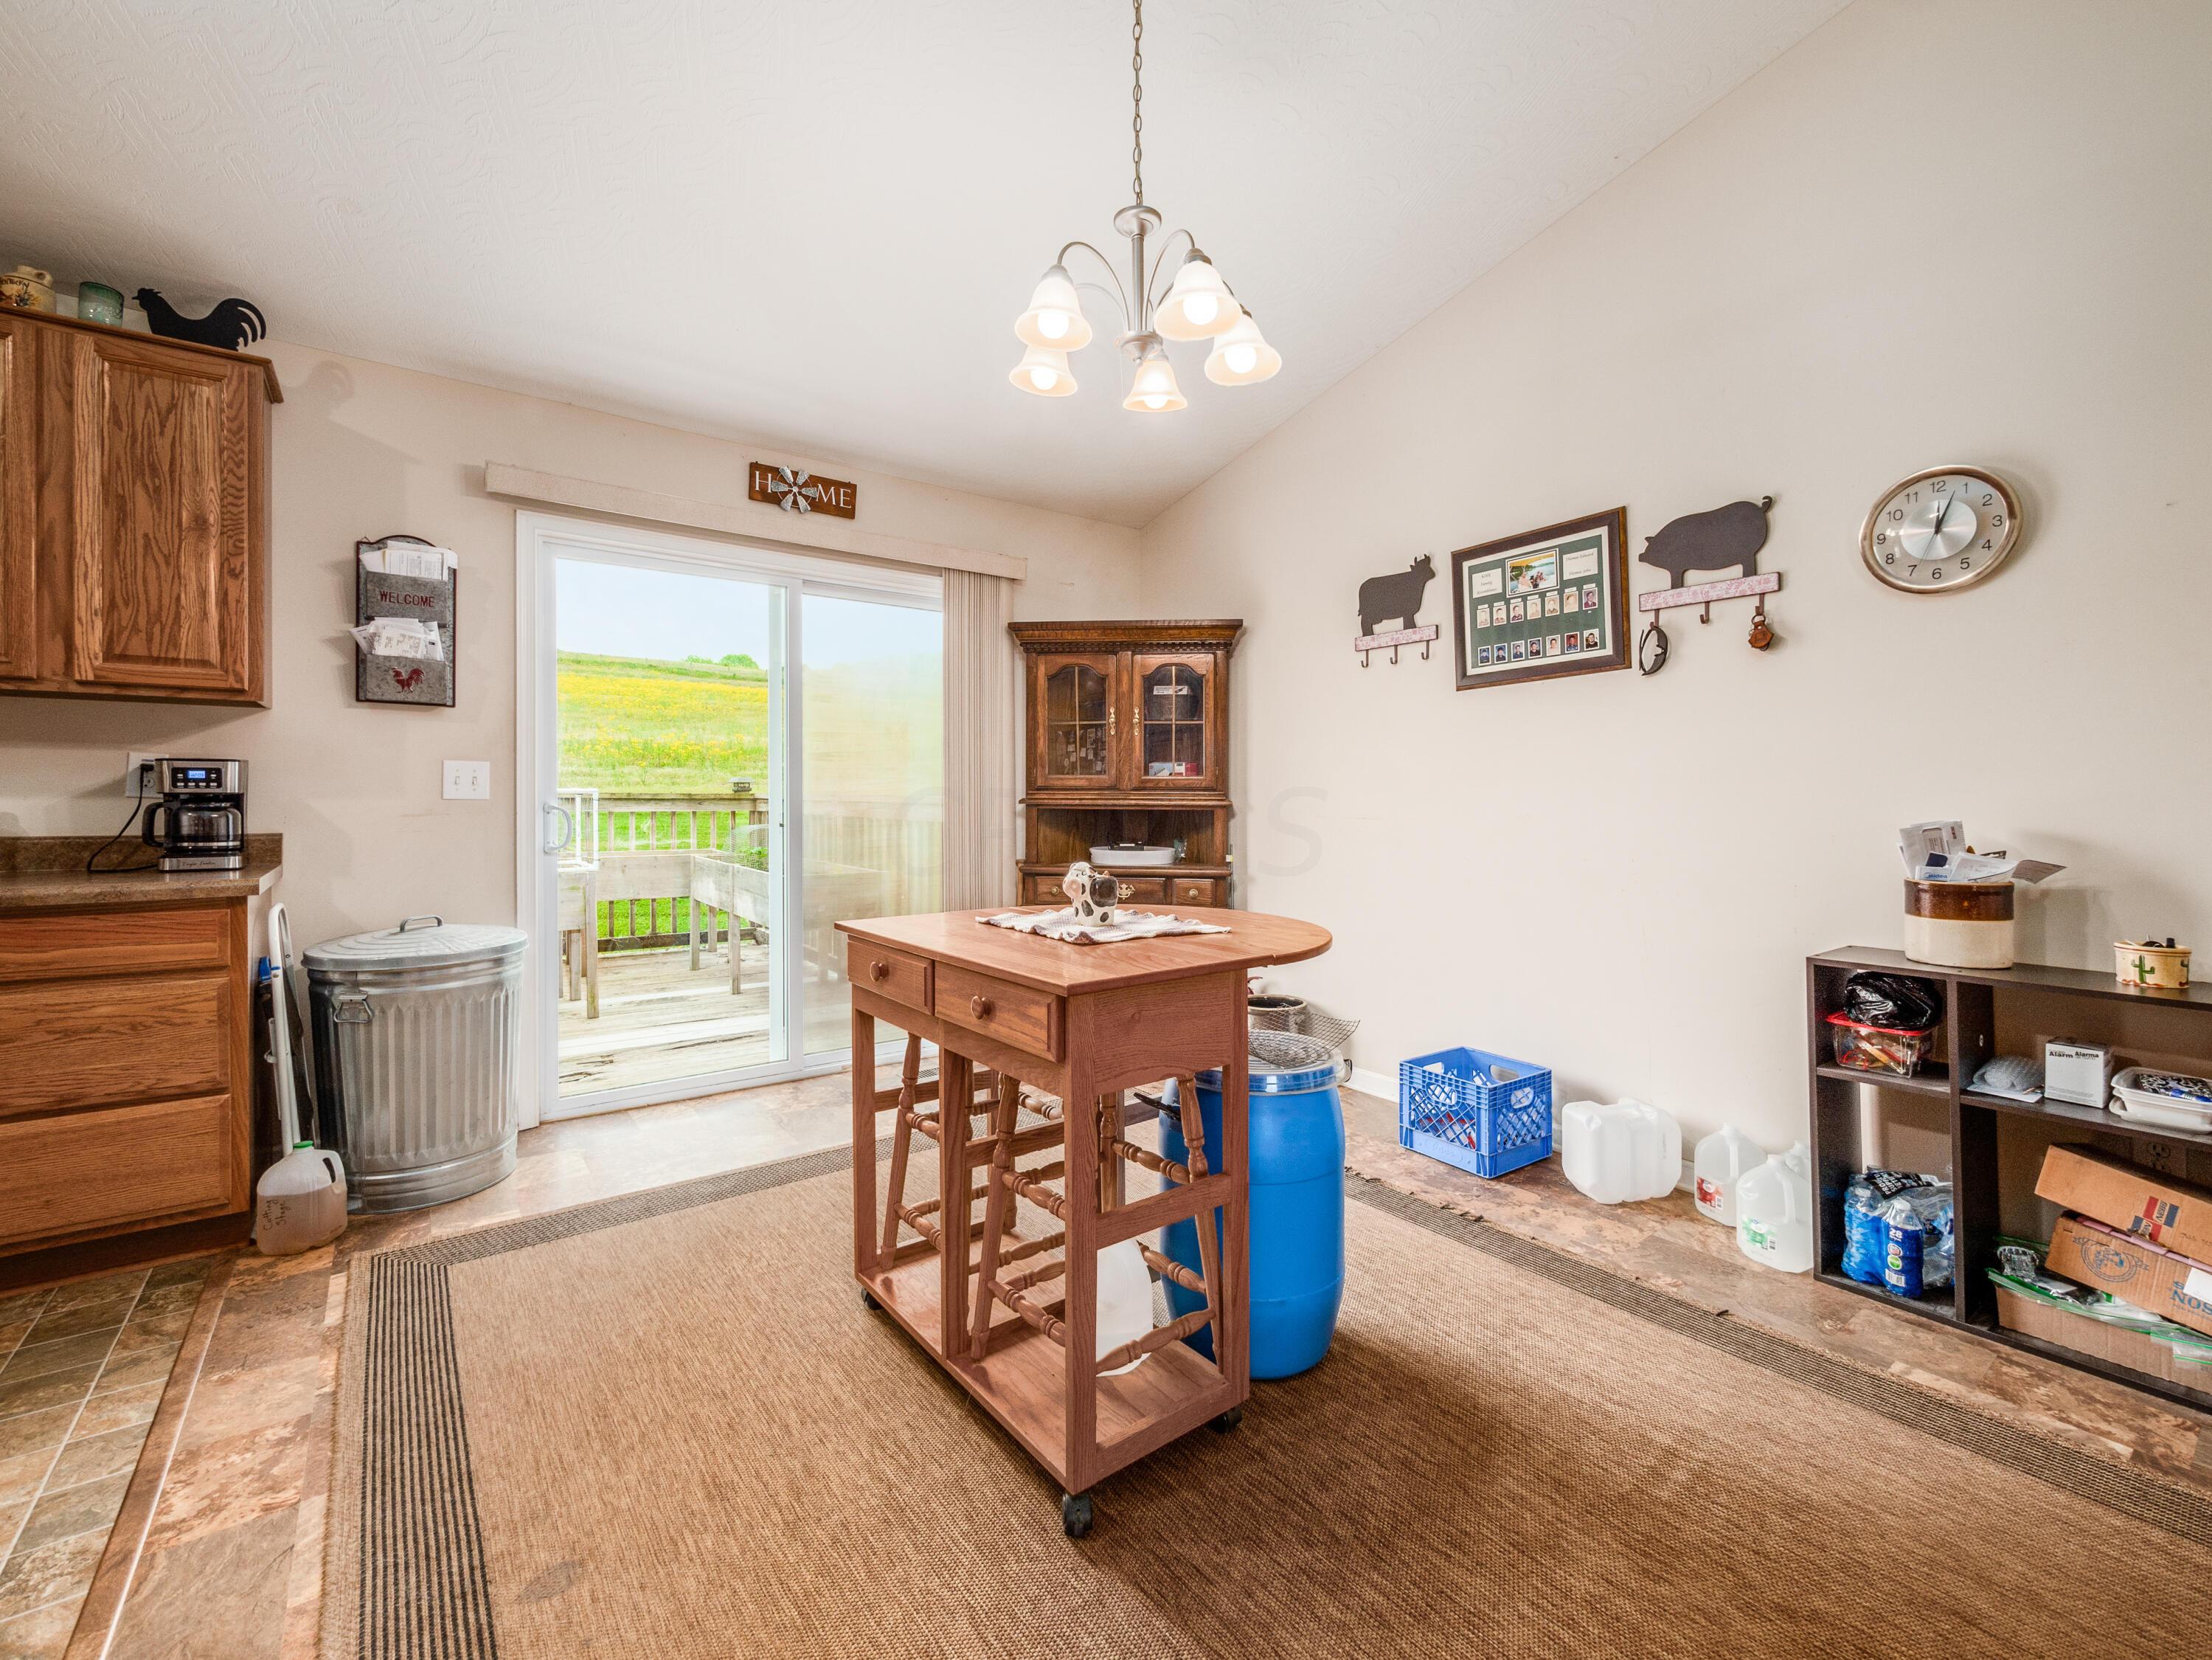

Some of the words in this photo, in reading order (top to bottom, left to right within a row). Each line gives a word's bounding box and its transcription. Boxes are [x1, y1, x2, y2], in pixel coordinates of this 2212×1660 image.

[1930, 480, 1946, 493] 12
[1962, 482, 1968, 494] 1
[1904, 491, 1918, 504] 11
[1982, 494, 1992, 506] 2
[1886, 509, 1904, 522] 10
[1992, 515, 2003, 527] 3
[1876, 533, 1886, 544] 9
[1982, 539, 1992, 551] 4
[1885, 553, 1894, 564] 8
[1960, 558, 1970, 570] 5
[1907, 564, 1917, 576] 7
[1932, 568, 1942, 579] 6
[380, 591, 435, 607] WELCOME
[2049, 1051, 2073, 1059] Alarm
[263, 1199, 279, 1231] Cutting
[275, 1200, 291, 1225] Stage
